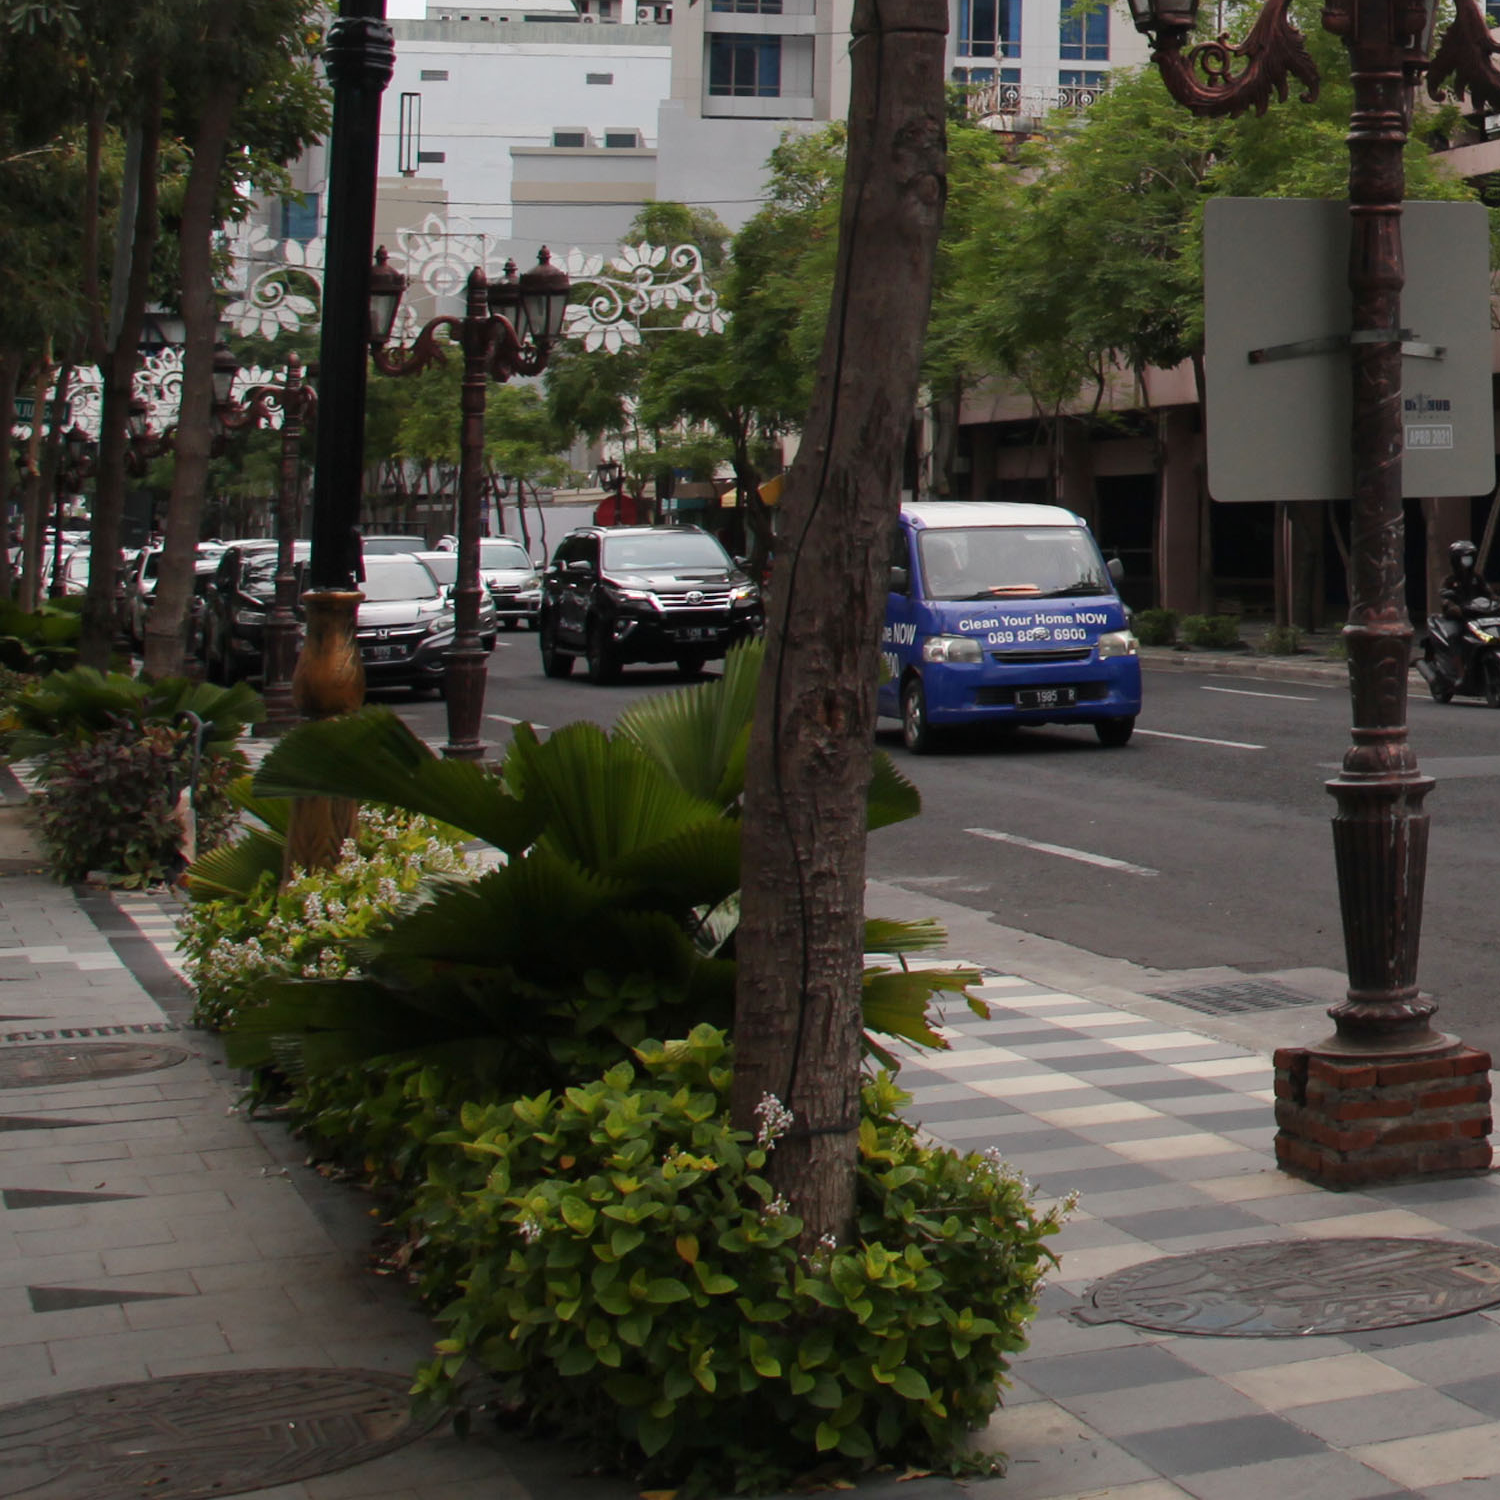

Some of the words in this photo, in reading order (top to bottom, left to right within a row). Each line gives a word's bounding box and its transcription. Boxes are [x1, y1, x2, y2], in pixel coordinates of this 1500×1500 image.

[959, 618, 999, 631] Clean
[1000, 615, 1032, 627] Your
[1034, 613, 1073, 625] Home
[1076, 612, 1108, 624] NOW
[893, 622, 917, 646] NOW
[988, 631, 1014, 644] 089
[1054, 628, 1087, 641] 6900
[1015, 691, 1023, 704] L
[1068, 688, 1076, 701] R
